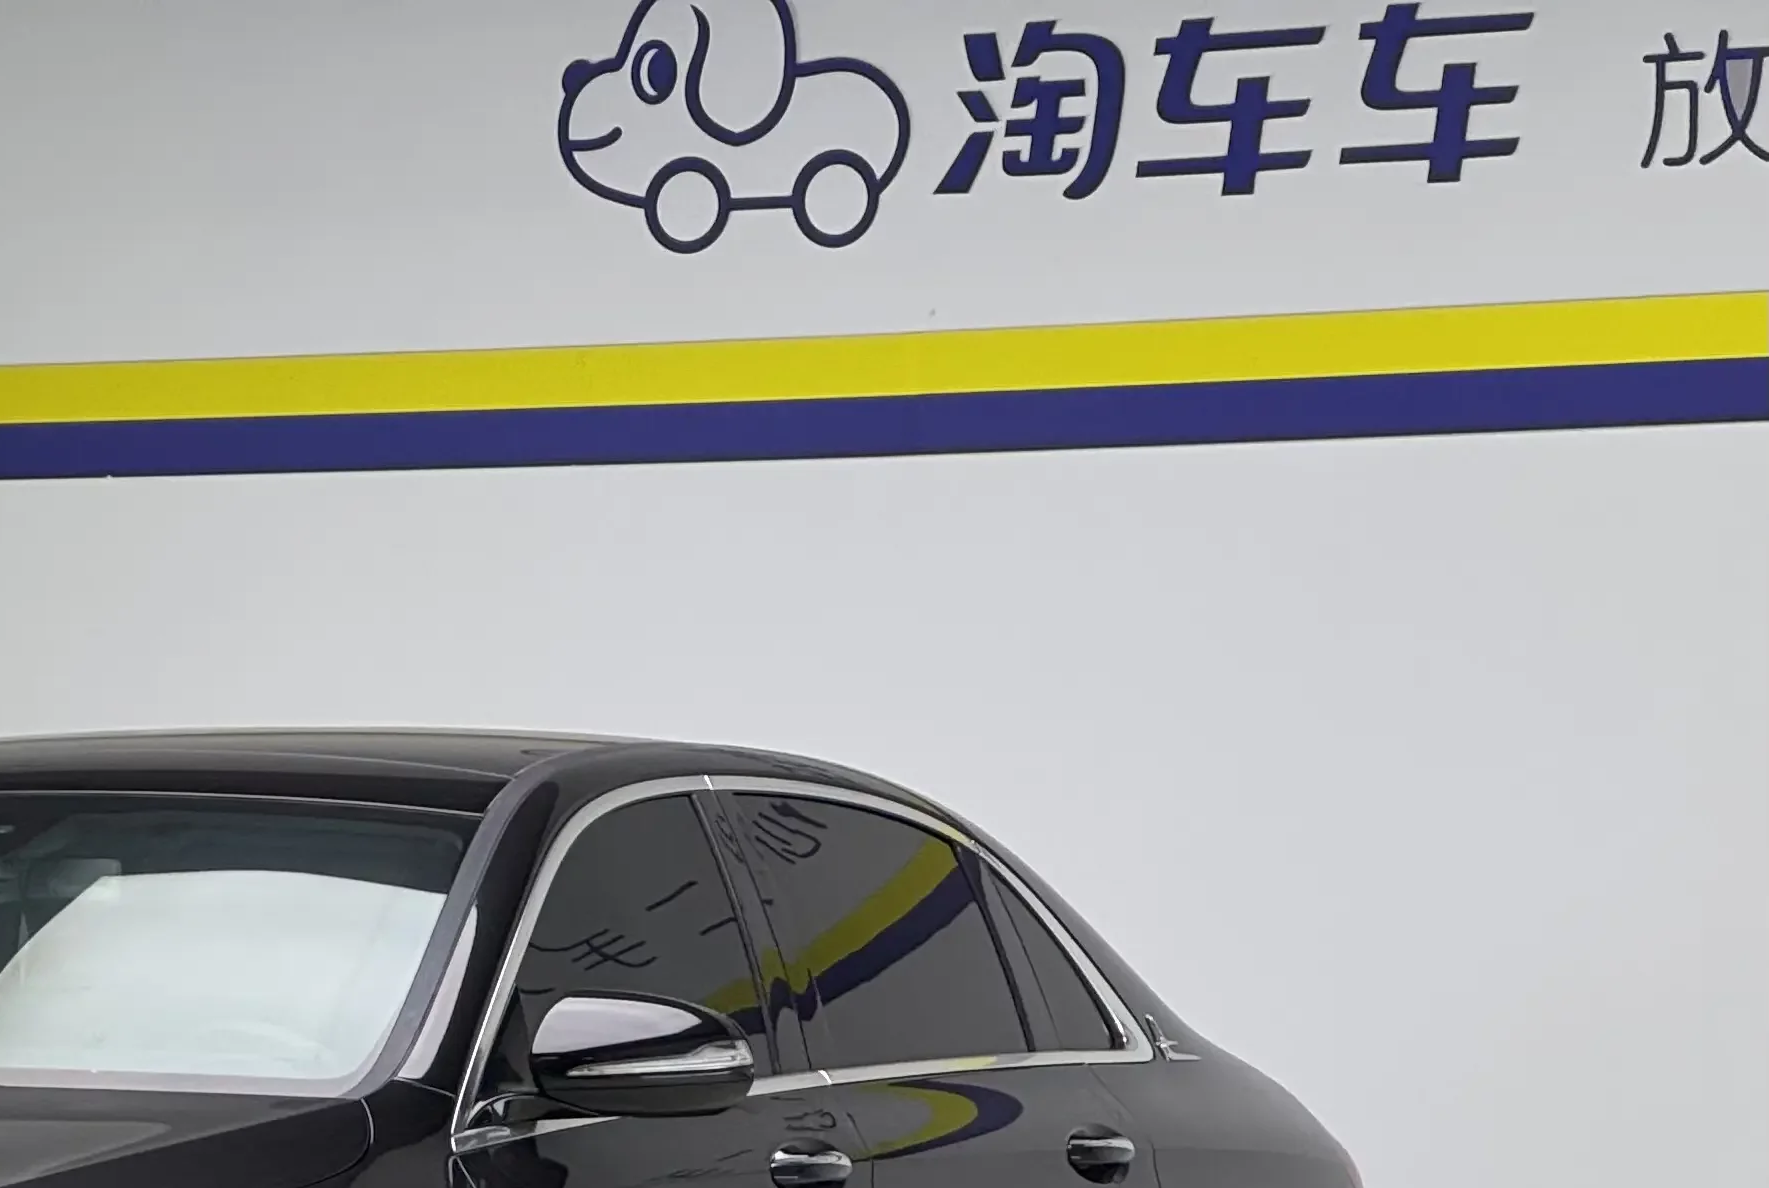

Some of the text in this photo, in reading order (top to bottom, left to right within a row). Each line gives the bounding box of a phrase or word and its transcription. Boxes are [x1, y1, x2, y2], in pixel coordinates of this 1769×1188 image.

[933, 2, 1536, 200] 淘车车
[1640, 29, 1769, 169] 放
